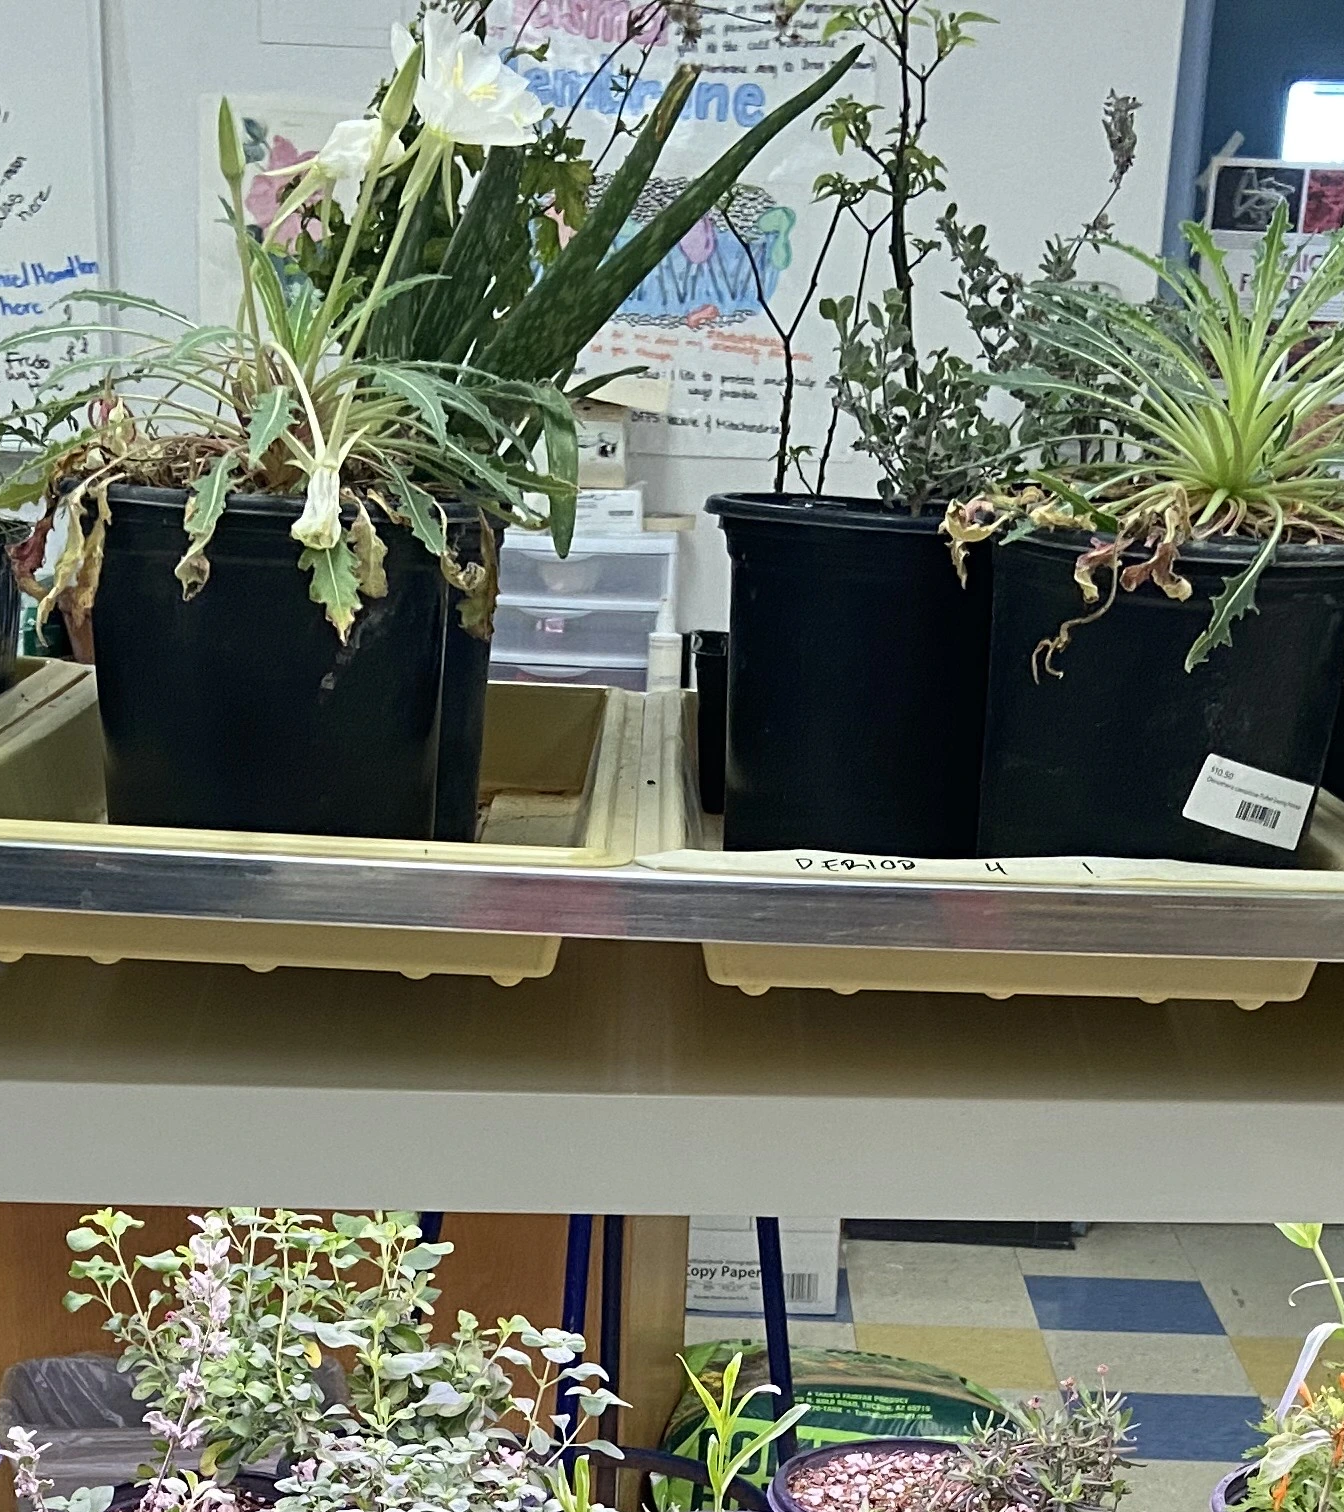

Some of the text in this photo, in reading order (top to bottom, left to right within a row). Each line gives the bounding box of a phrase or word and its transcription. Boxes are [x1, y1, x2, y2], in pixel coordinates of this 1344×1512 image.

[1210, 765, 1235, 780] $10.50
[985, 861, 1008, 875] 4
[720, 1264, 762, 1280] Paper
